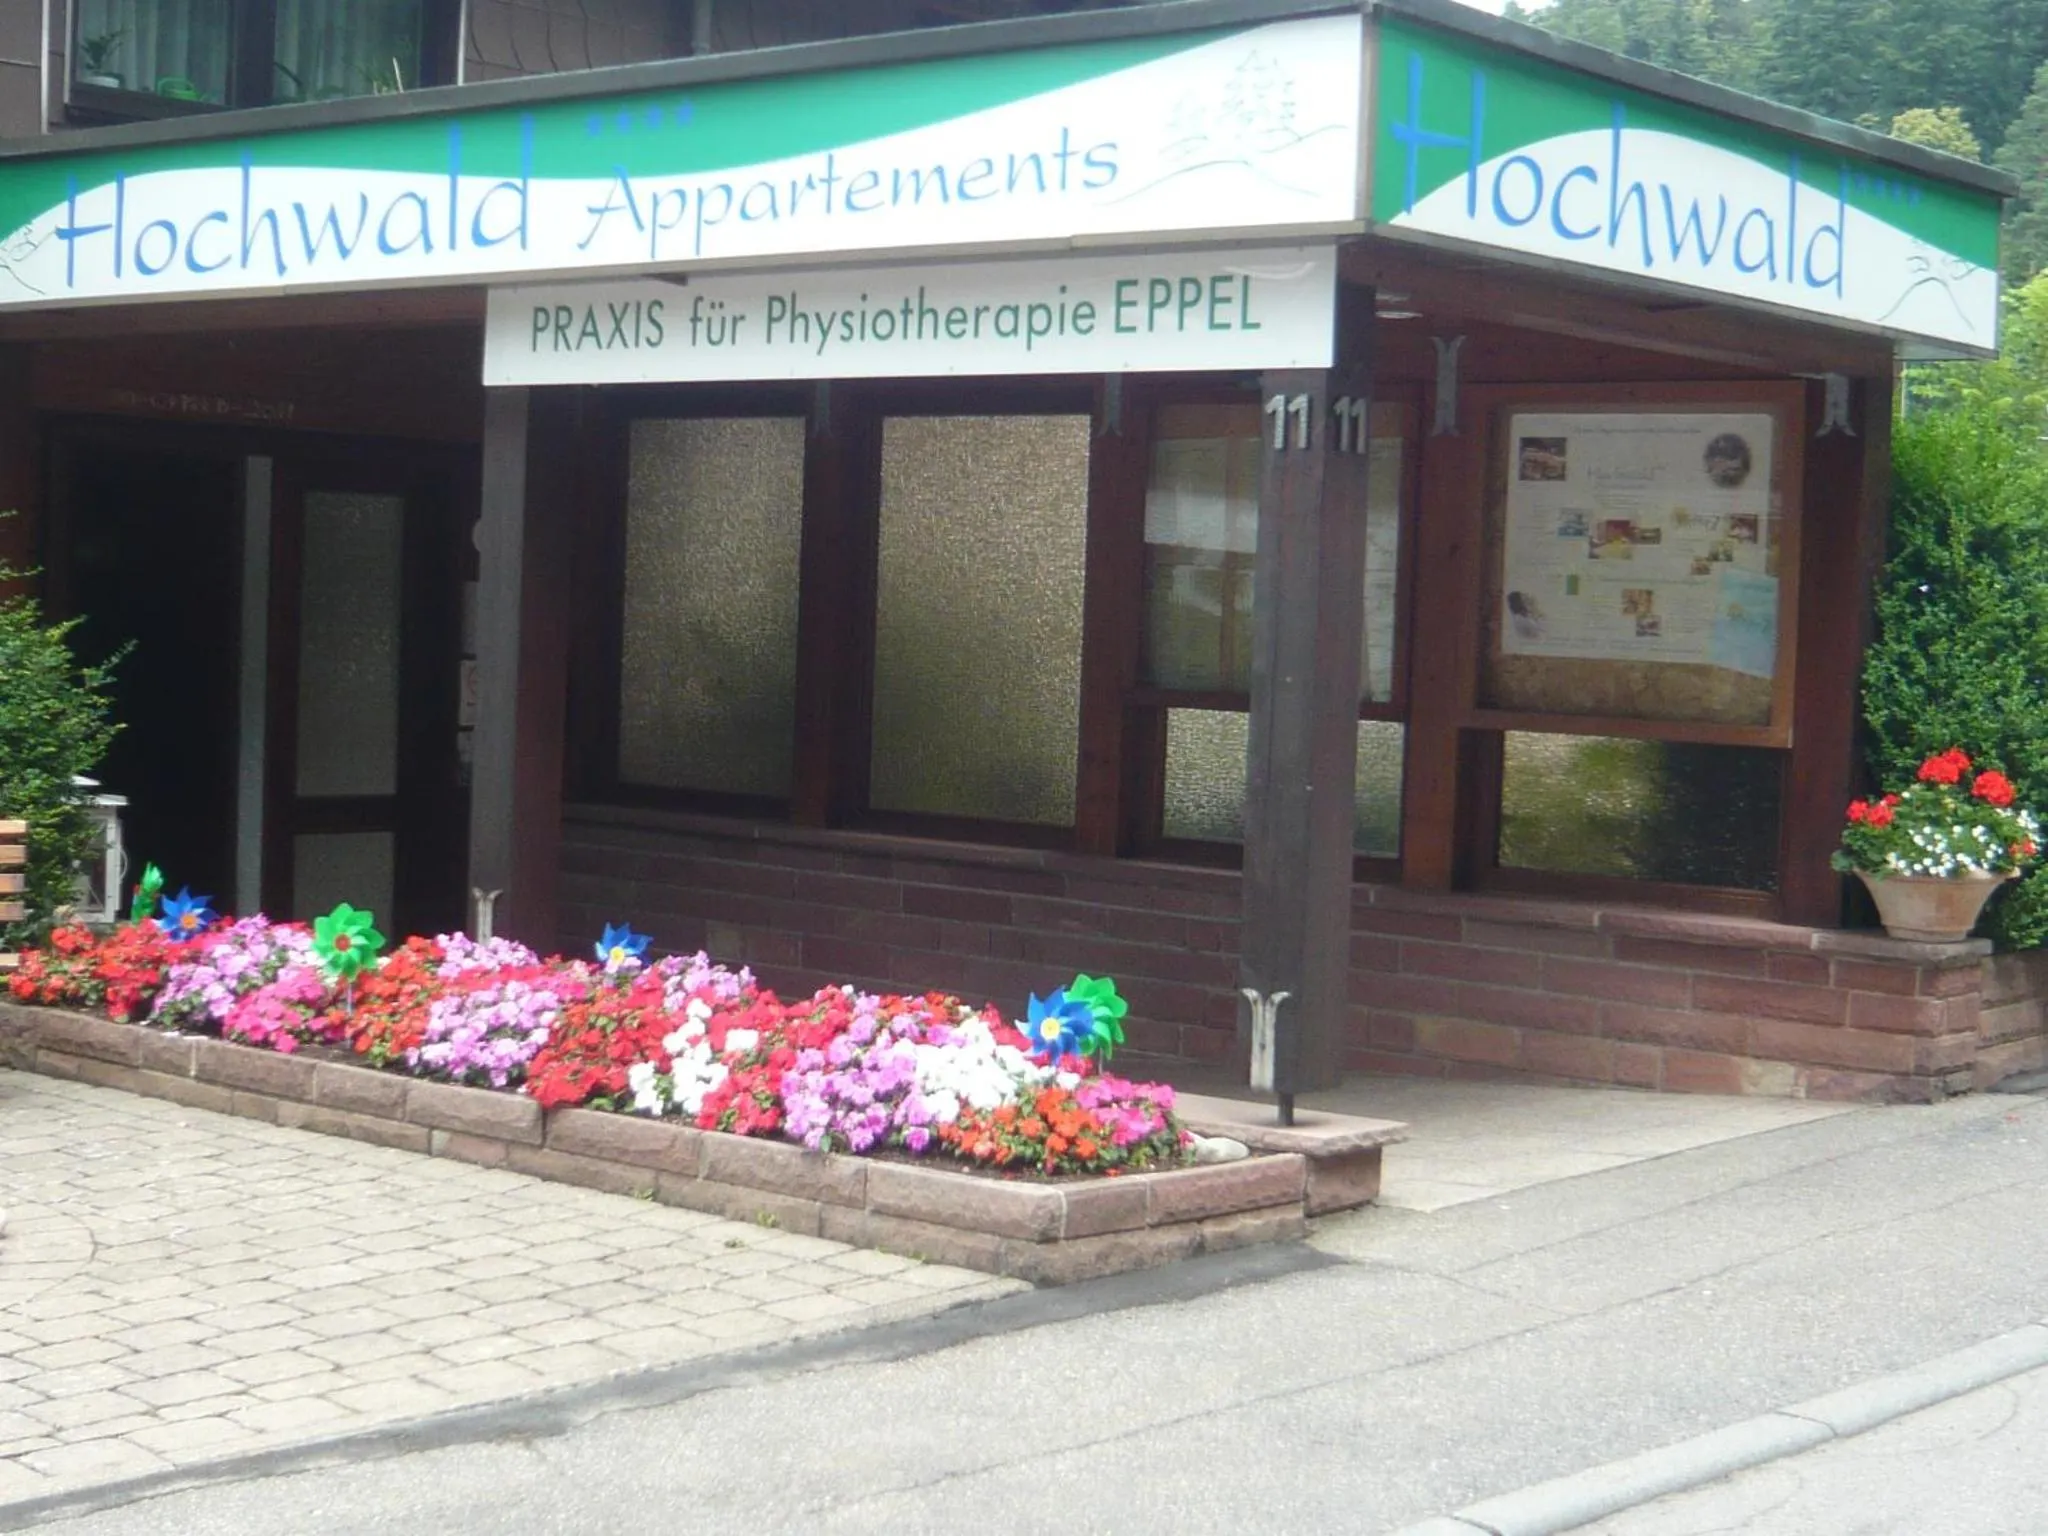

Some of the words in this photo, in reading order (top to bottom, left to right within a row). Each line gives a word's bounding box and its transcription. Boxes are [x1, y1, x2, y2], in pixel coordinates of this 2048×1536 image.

[57, 113, 535, 288] Hochwald
[577, 126, 1120, 260] Appartements
[1389, 49, 1848, 300] Hochwald
[531, 299, 665, 352] PRAXIS
[689, 294, 746, 347] für
[765, 284, 1097, 355] Physiotherapie
[1114, 274, 1262, 334] EPPEL
[1264, 393, 1310, 450] 11
[1332, 395, 1368, 455] 11
